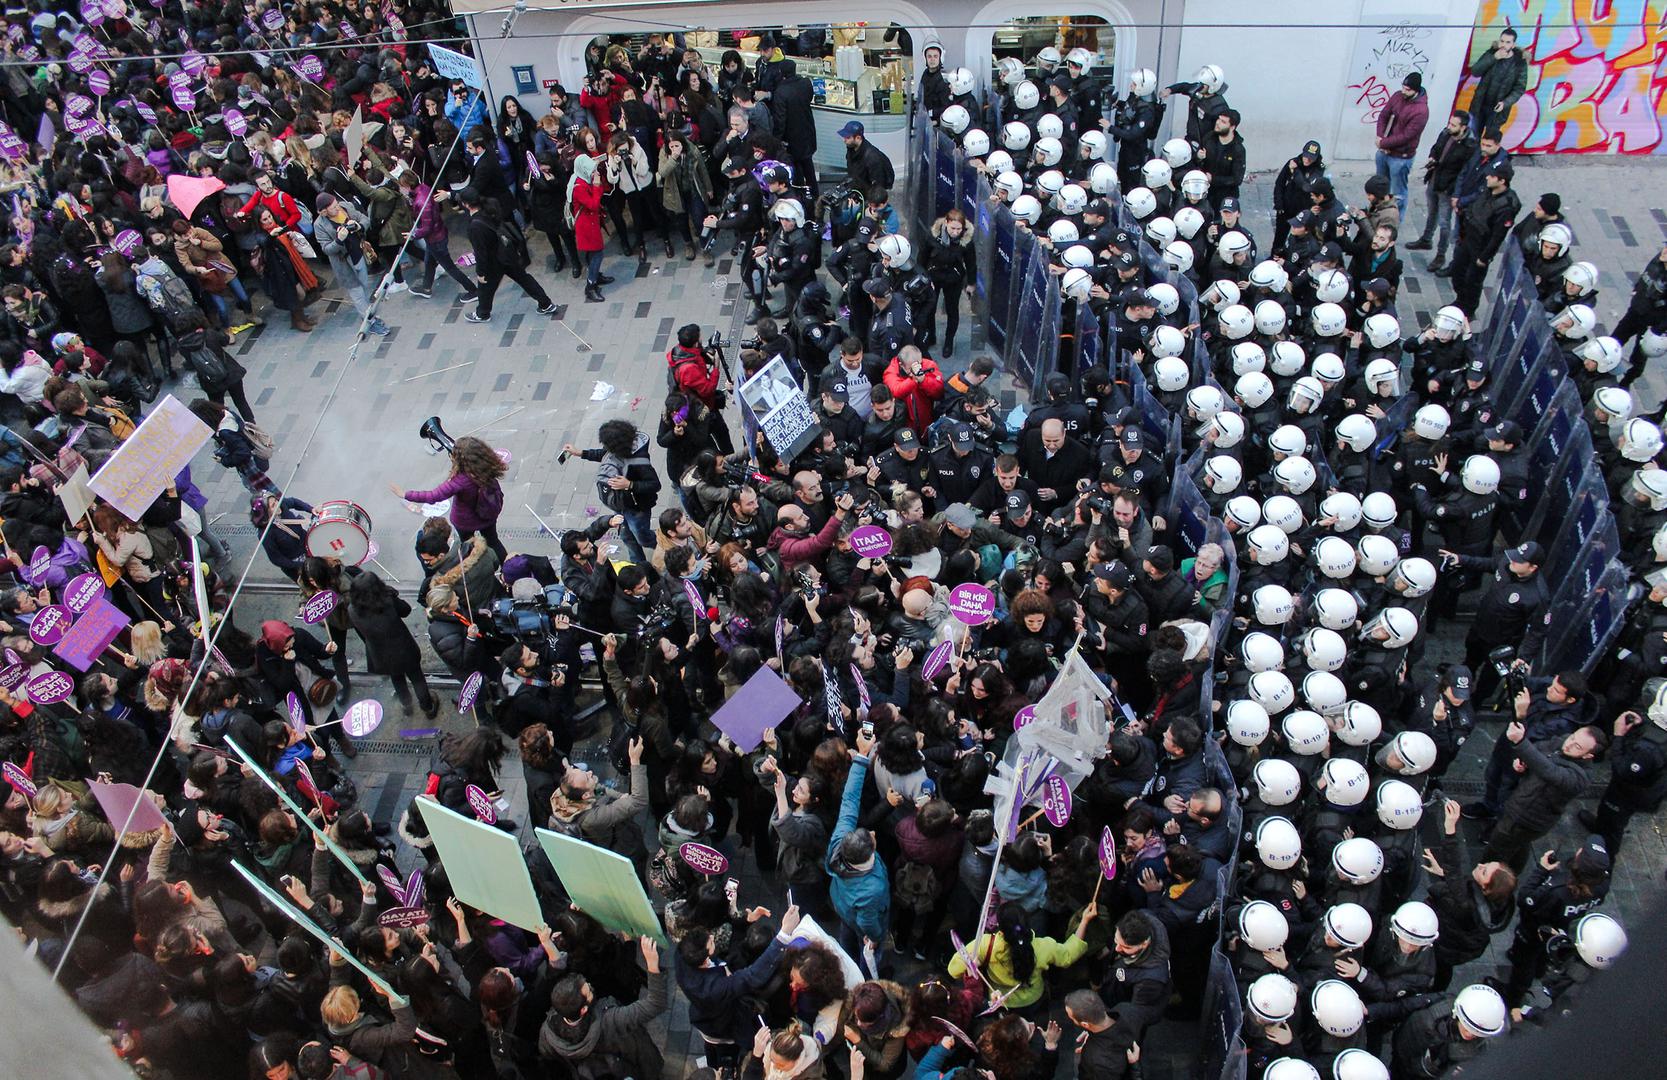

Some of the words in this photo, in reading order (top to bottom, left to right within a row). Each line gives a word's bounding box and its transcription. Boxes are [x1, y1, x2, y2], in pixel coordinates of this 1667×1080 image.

[854, 533, 885, 547] İTAAT
[68, 592, 81, 608] AİLE
[73, 578, 103, 612] KADINIZ
[959, 590, 972, 600] BİR
[973, 591, 988, 603] KİŞİ
[307, 603, 333, 622] GÜÇLÜ
[960, 599, 983, 610] DAHA
[28, 672, 60, 692] KADINLAR
[40, 683, 71, 702] GÜÇLÜ
[1054, 778, 1068, 821] HAYATI
[686, 843, 723, 861] KADINLAR
[684, 855, 721, 872] GÜÇLÜ
[381, 909, 426, 921] HAYATI
